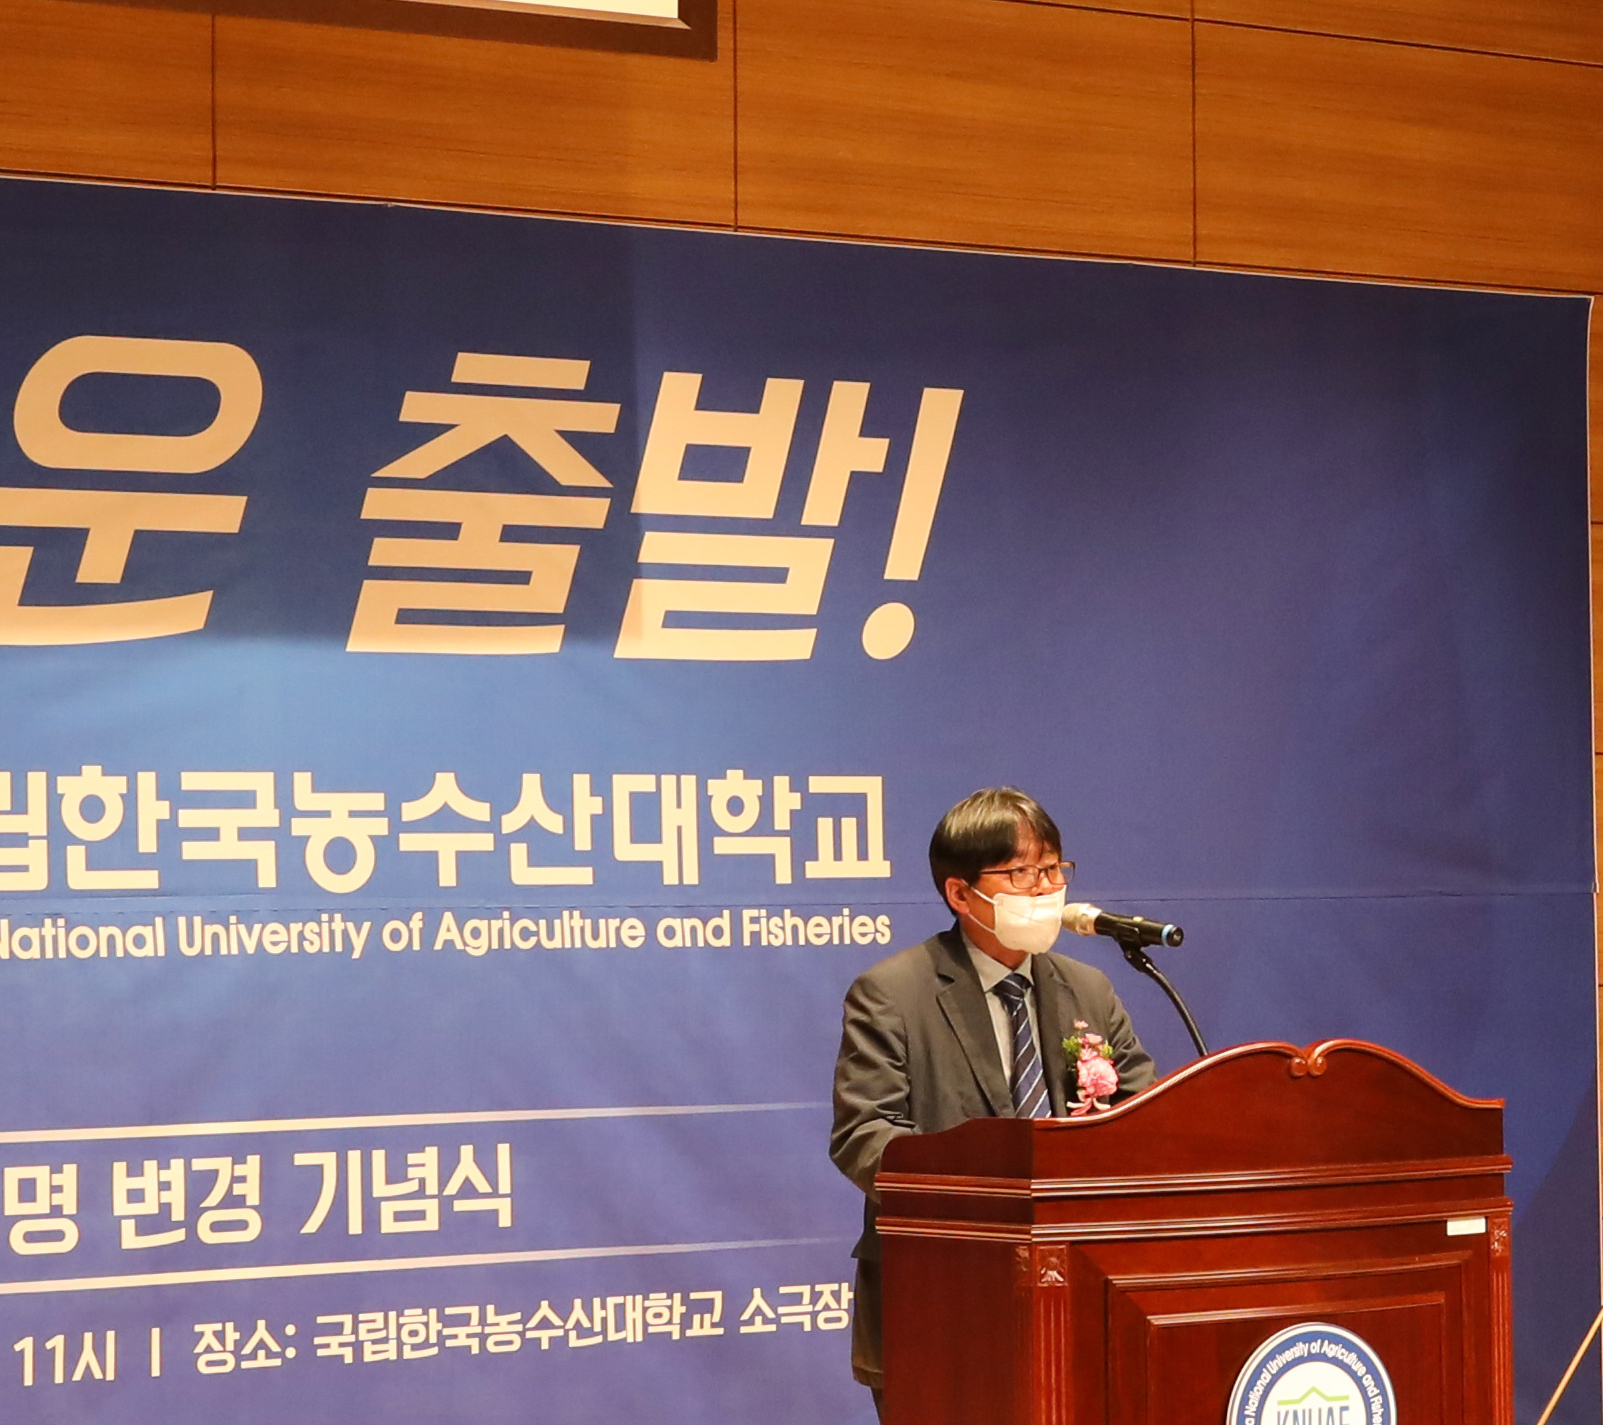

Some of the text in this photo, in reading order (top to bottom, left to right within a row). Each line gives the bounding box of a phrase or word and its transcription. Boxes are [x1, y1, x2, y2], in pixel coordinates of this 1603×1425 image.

[345, 352, 965, 662] 출발!
[176, 913, 372, 960] University
[381, 911, 424, 952] of
[433, 909, 646, 957] Agriculture
[656, 909, 731, 948] and
[741, 907, 891, 947] Fisheries
[112, 1154, 263, 1250] 변경
[293, 1142, 512, 1235] 기념식
[13, 1330, 116, 1387] 11시
[193, 1319, 297, 1375] 장소:
[313, 1290, 725, 1364] 국립한국농수산대학교
[739, 1282, 853, 1334] 소극장
[1244, 1371, 1271, 1417] National
[1266, 1341, 1309, 1374] University
[1310, 1339, 1322, 1353] of
[1321, 1340, 1366, 1376] Agriculture
[1362, 1374, 1378, 1397] and
